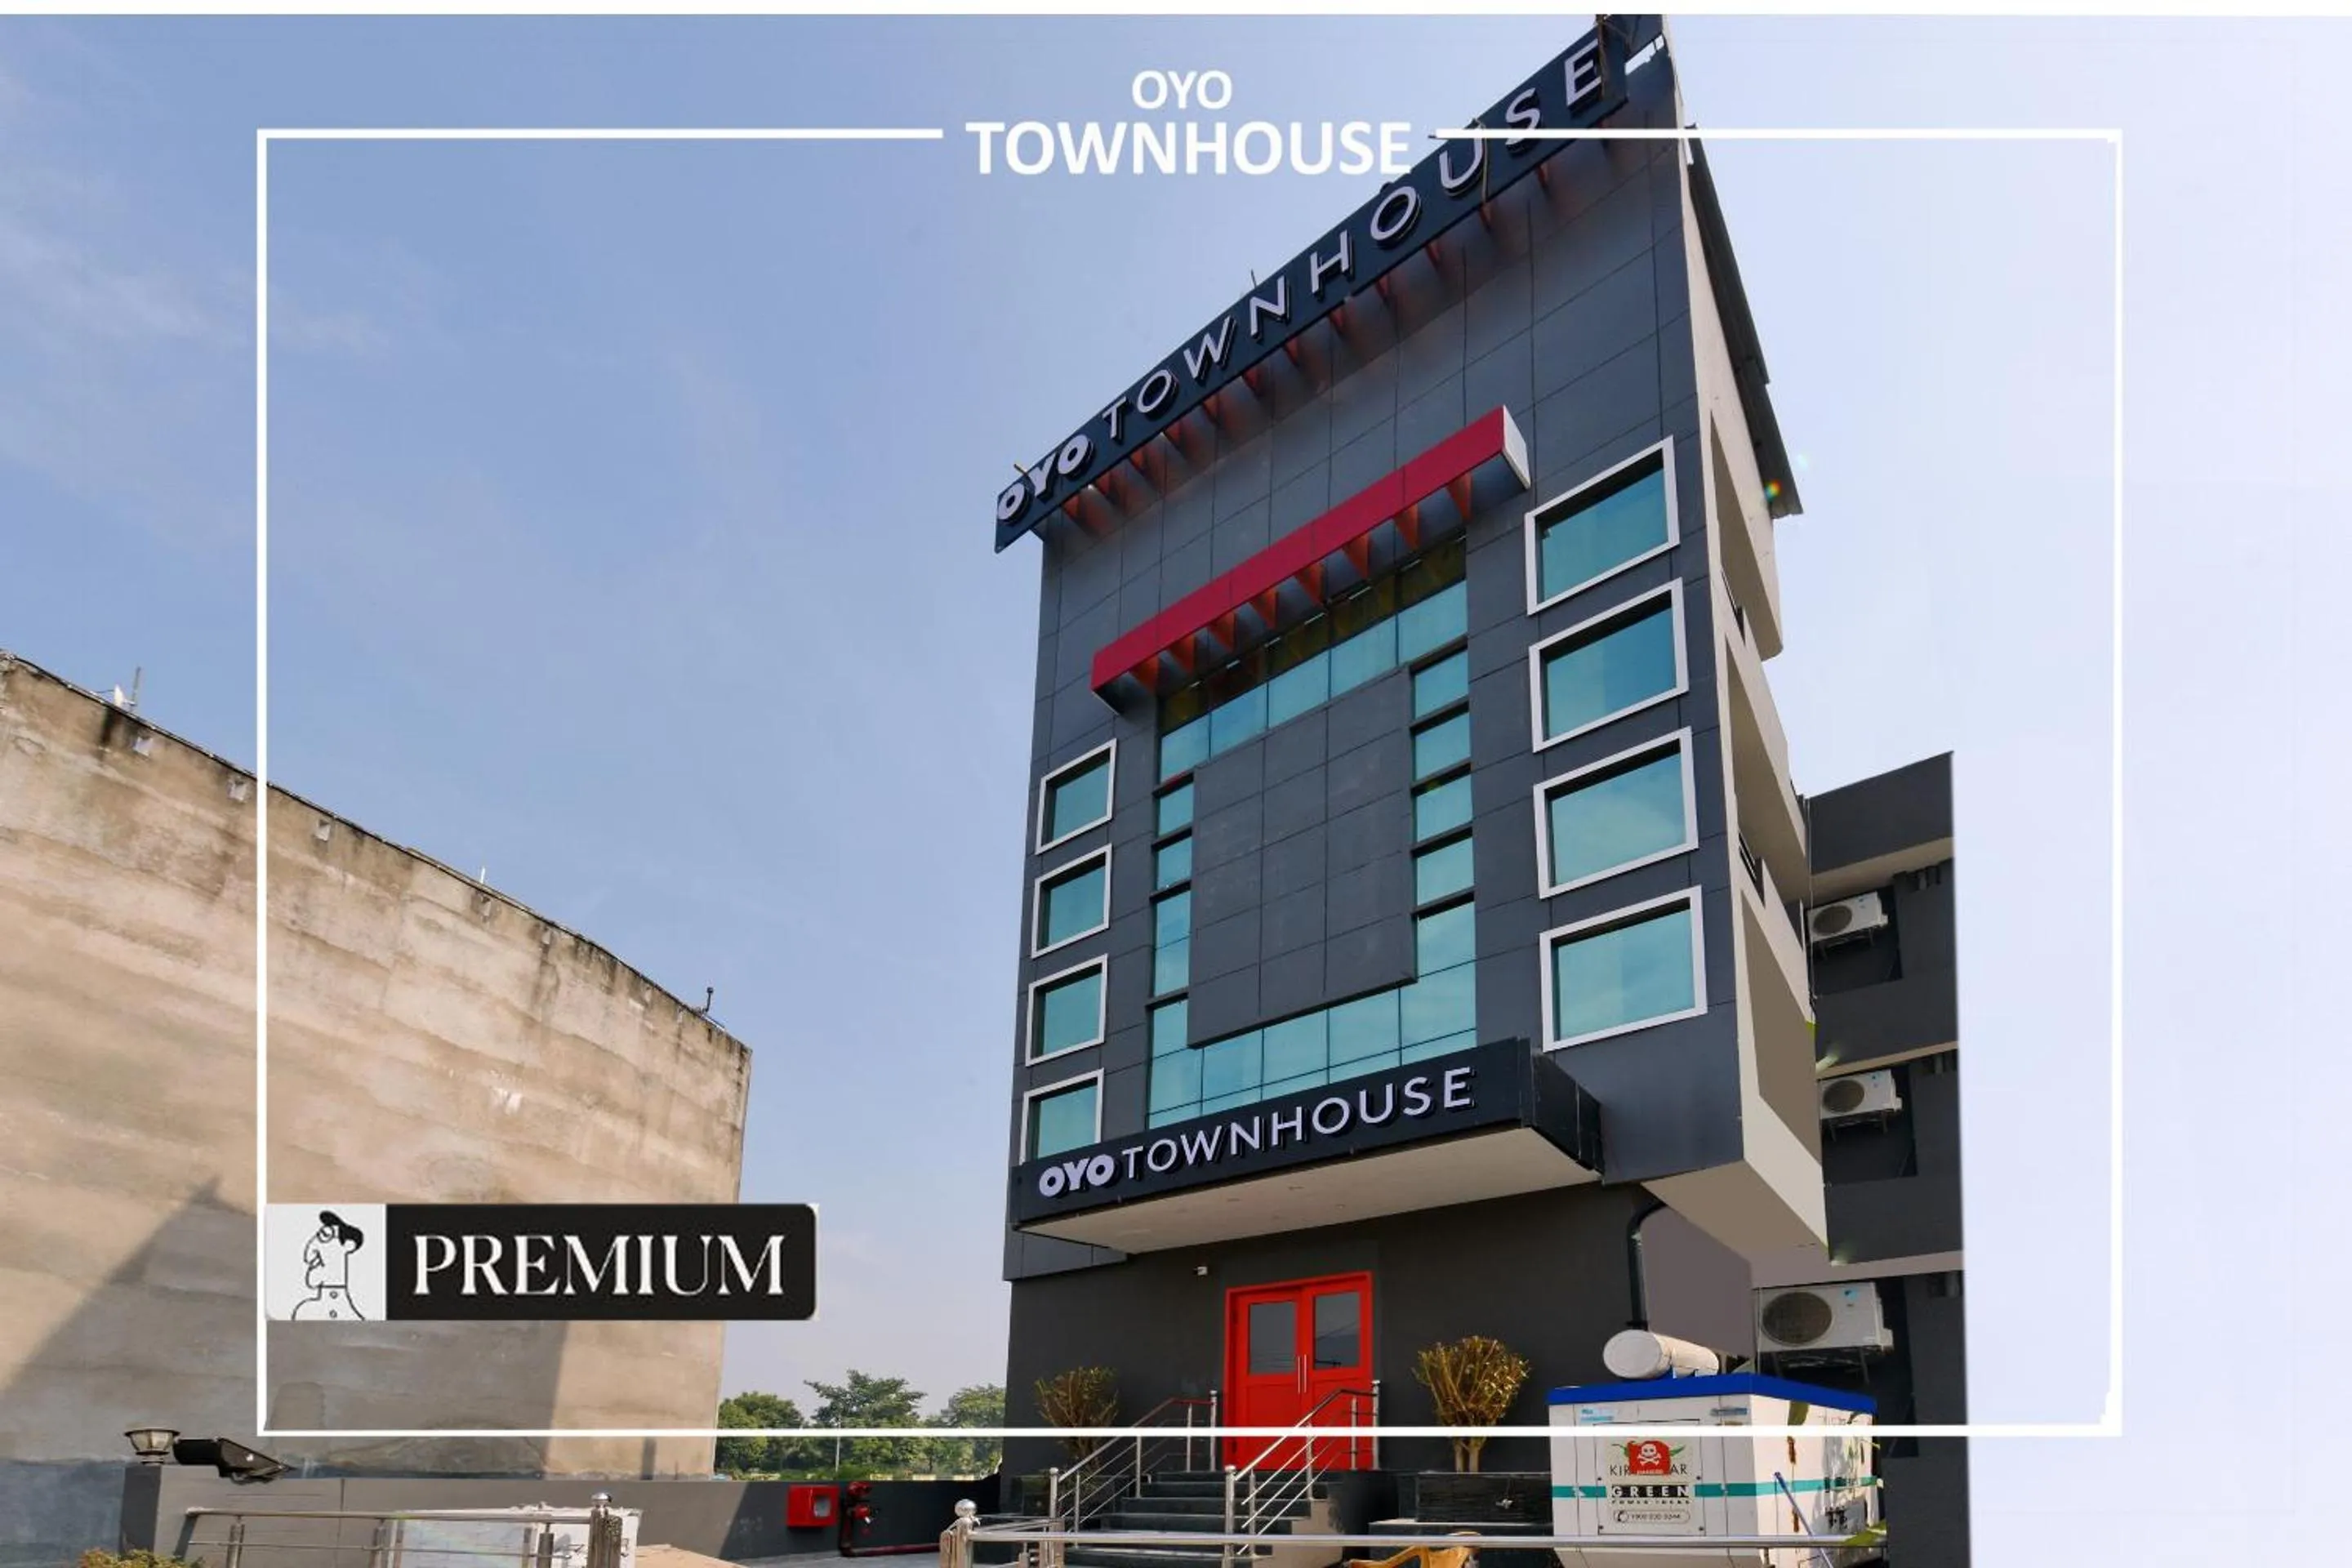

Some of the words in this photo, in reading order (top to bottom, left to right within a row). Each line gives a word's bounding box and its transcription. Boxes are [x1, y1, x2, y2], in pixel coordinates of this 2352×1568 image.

[997, 434, 1093, 523] OYO
[1102, 38, 1603, 441] TOWNHOUSE
[1039, 1153, 1115, 1198] OYO
[1122, 1066, 1475, 1179] TOWNHOUSE
[1612, 1485, 1690, 1498] GREEN
